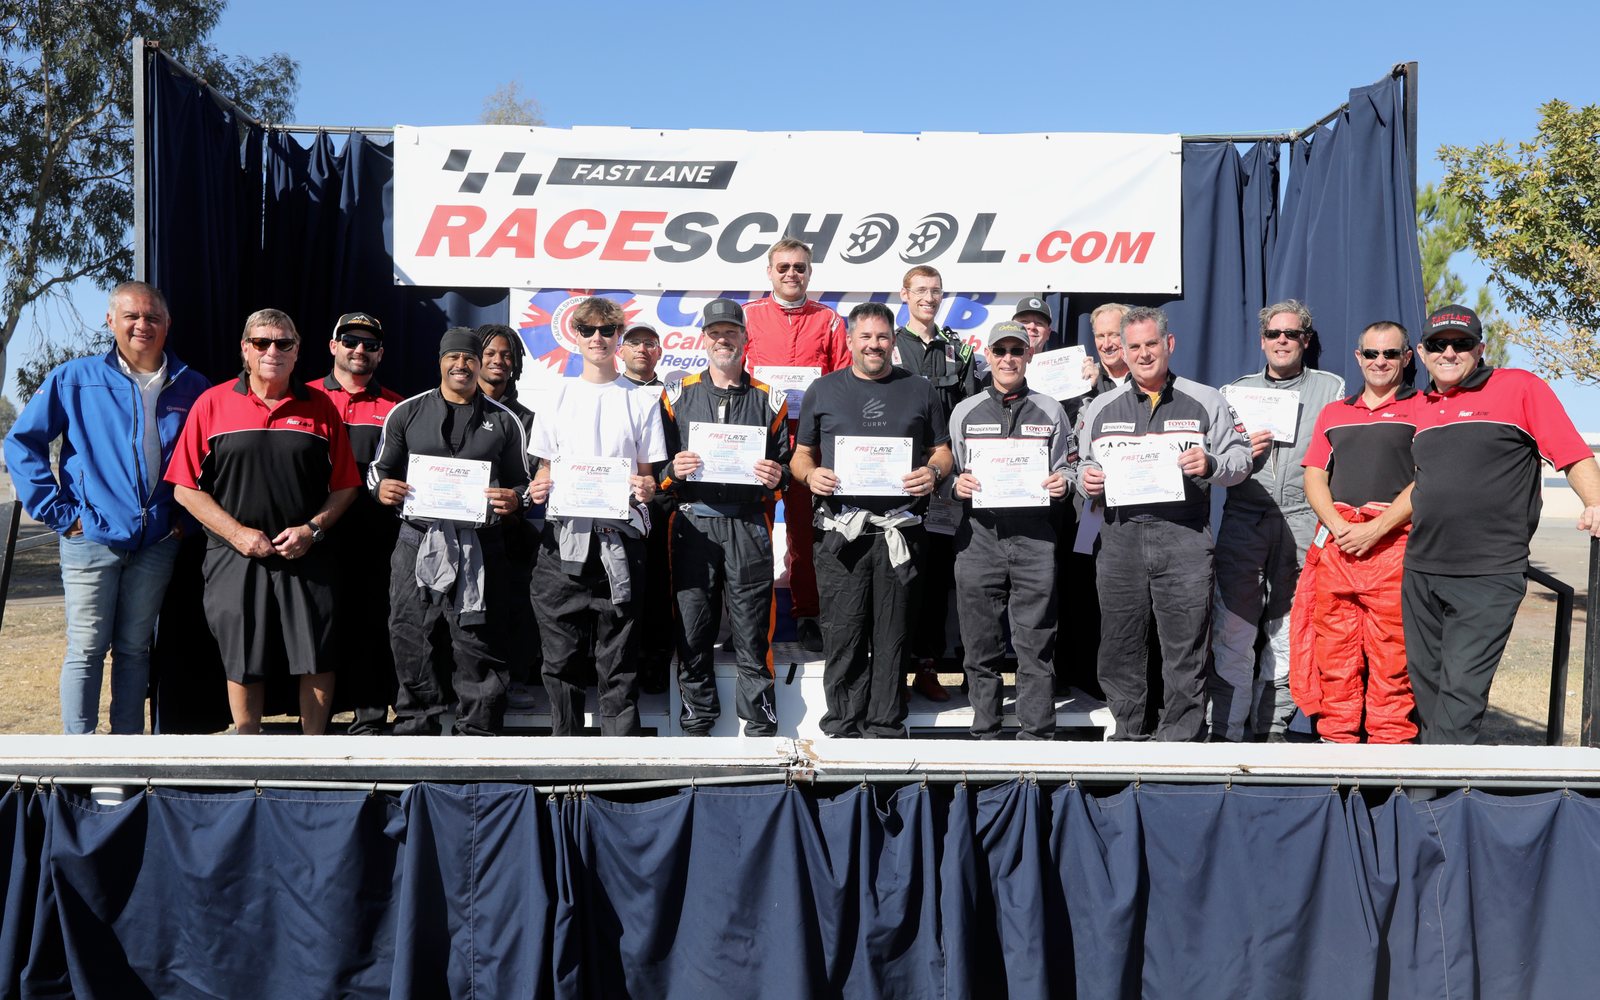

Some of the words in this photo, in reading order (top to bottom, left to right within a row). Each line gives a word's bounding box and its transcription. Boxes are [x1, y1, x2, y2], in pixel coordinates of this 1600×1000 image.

[571, 164, 641, 182] FAST
[644, 165, 716, 184] LANE
[660, 354, 710, 370] Regio
